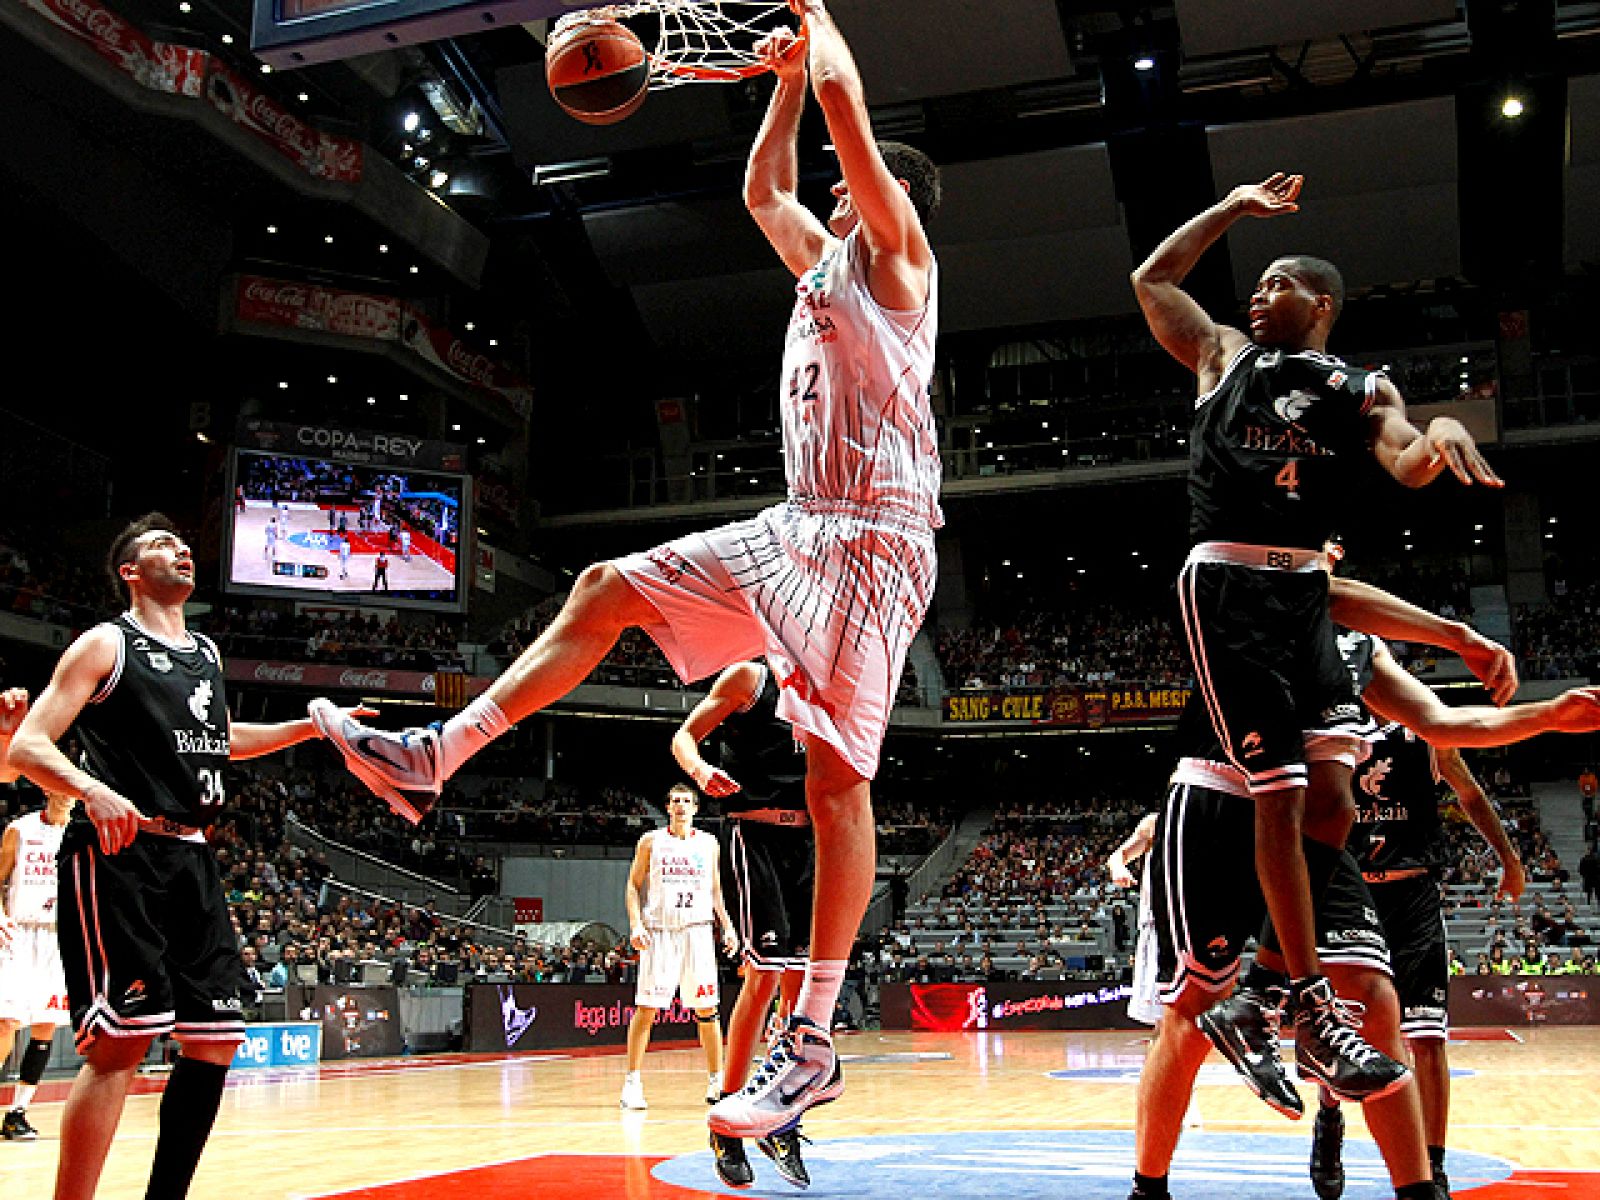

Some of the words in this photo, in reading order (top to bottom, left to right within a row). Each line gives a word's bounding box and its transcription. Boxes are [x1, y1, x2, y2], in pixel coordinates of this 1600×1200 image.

[374, 433, 425, 458] REY
[1274, 459, 1300, 493] 4
[254, 662, 306, 682] Coca-Cola
[339, 669, 387, 690] Coca-Cola
[1369, 834, 1386, 861] 7
[280, 1029, 311, 1061] tve
